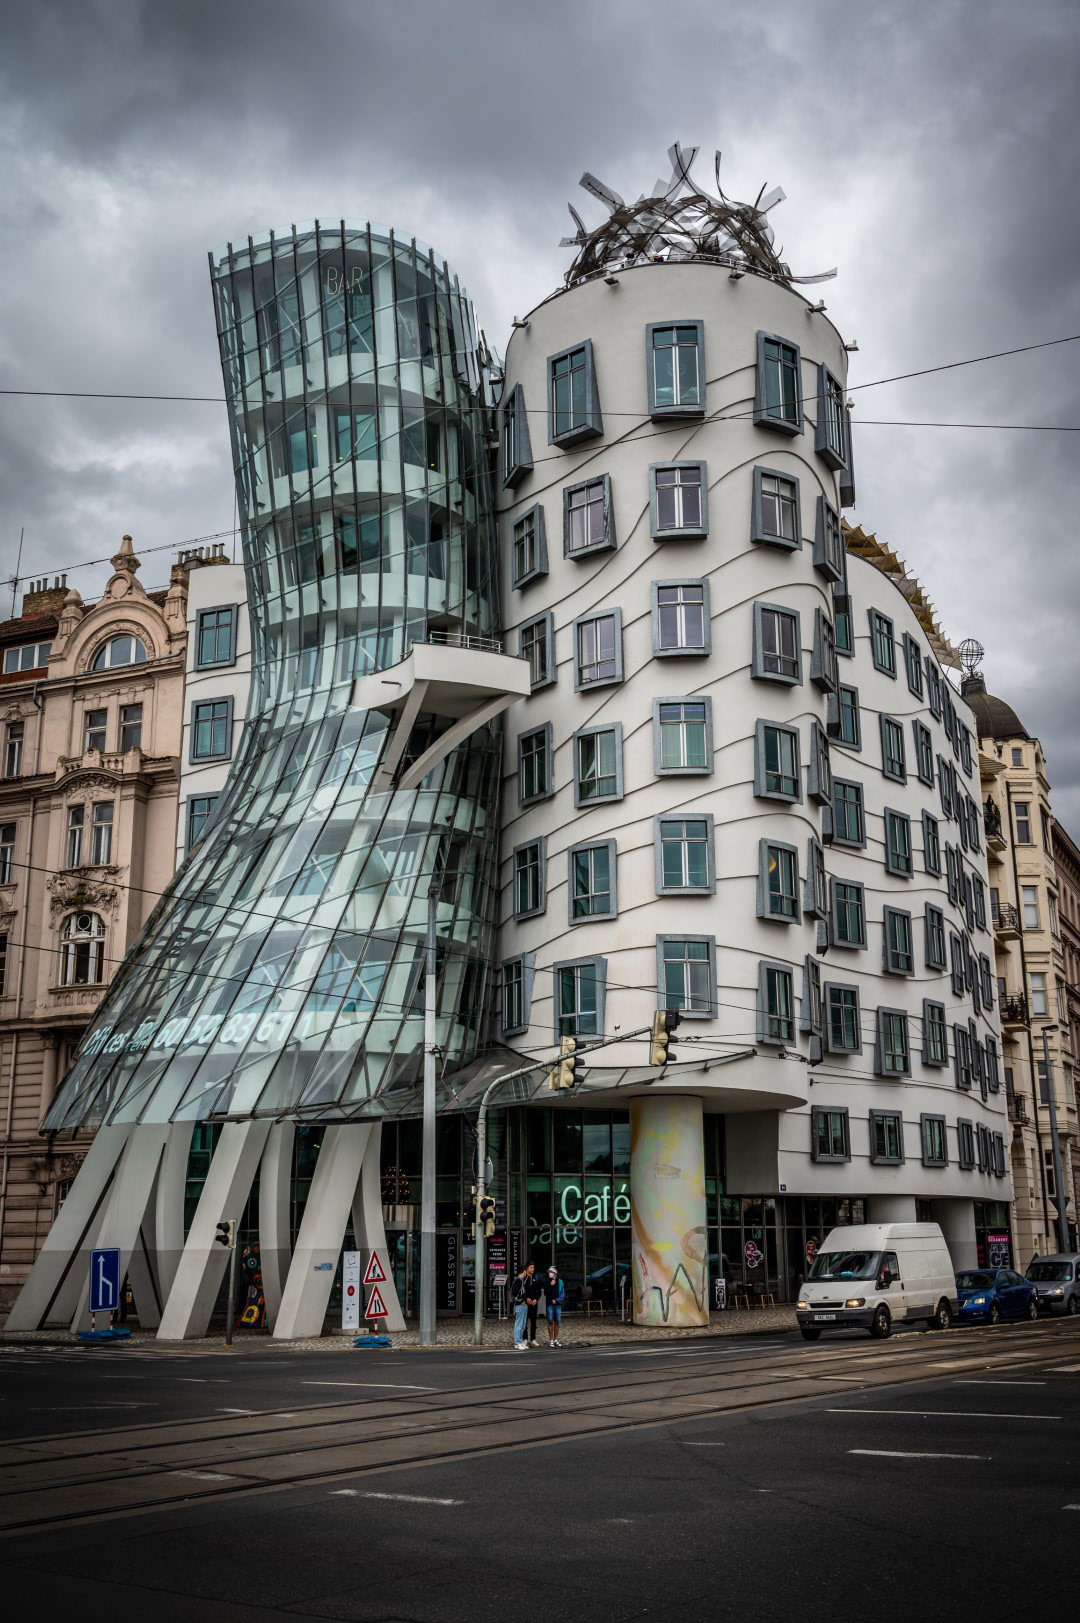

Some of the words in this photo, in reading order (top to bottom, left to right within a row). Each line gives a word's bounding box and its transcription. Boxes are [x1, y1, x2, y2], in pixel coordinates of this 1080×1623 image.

[327, 266, 363, 295] BAR
[561, 1183, 632, 1224] Café
[447, 1236, 457, 1277] GLASS
[447, 1281, 456, 1308] BAR
